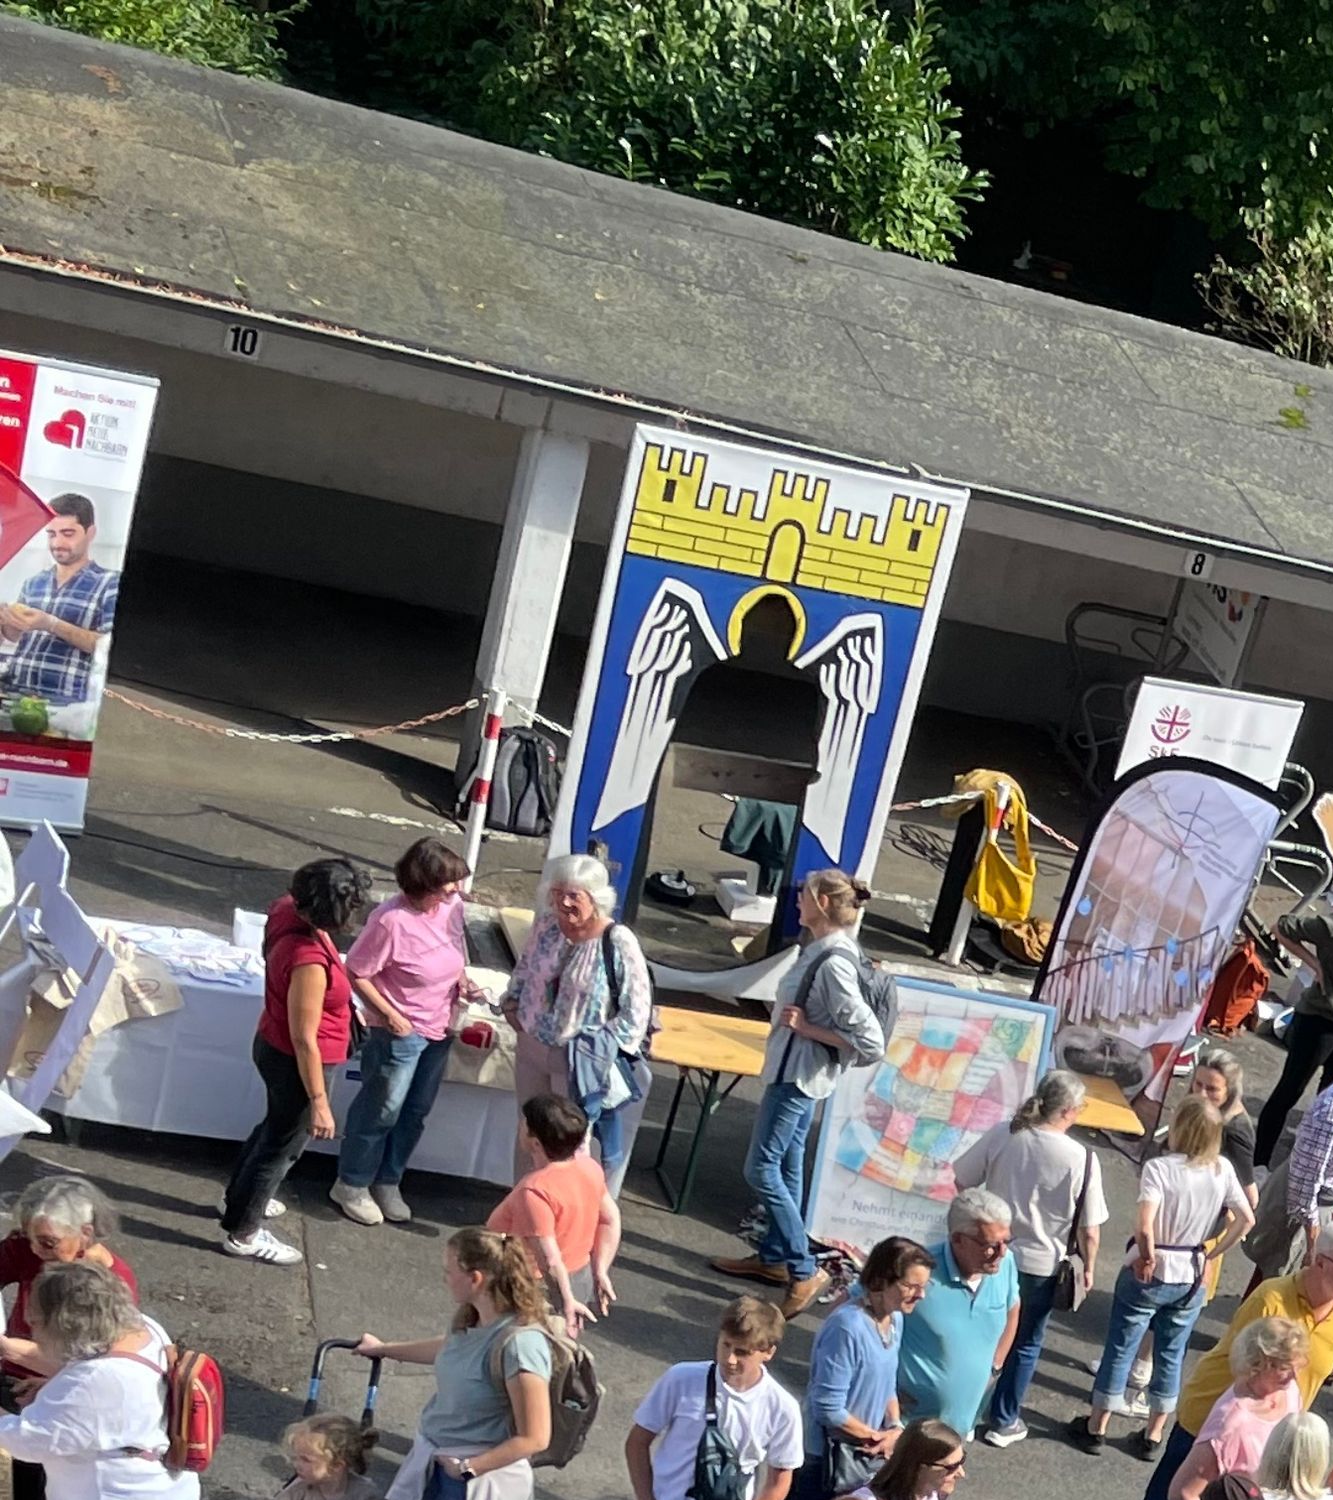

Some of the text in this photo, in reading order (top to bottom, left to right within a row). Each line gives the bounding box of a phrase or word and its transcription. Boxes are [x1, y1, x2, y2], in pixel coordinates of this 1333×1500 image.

[230, 326, 258, 356] 10
[1191, 553, 1206, 576] 8
[852, 1200, 896, 1217] Nehmt
